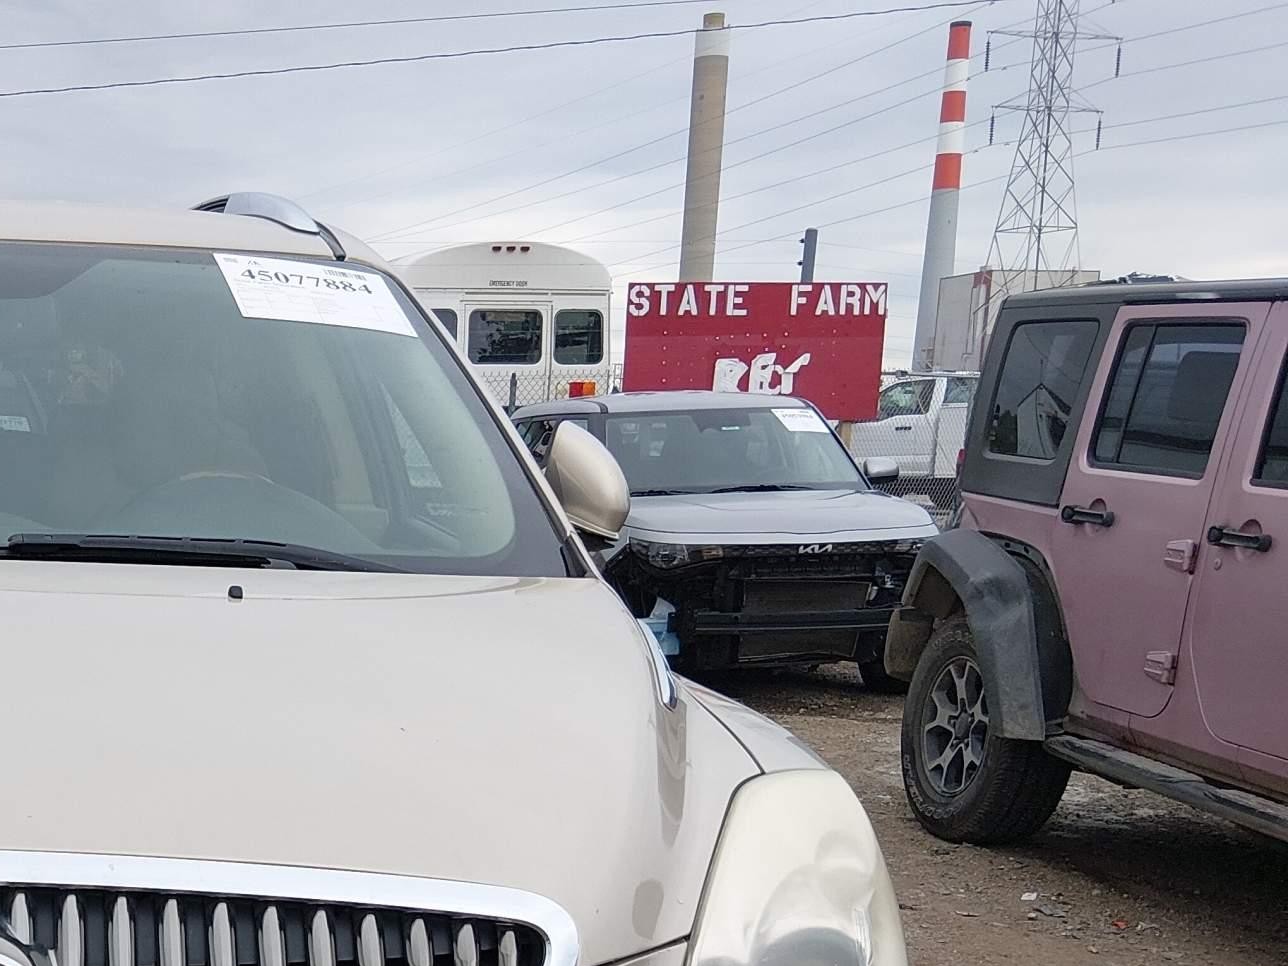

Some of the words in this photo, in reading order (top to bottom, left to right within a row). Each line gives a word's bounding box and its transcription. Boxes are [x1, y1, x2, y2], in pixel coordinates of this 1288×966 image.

[240, 268, 373, 295] 45077884
[629, 284, 750, 317] STATE
[790, 284, 887, 316] FARM
